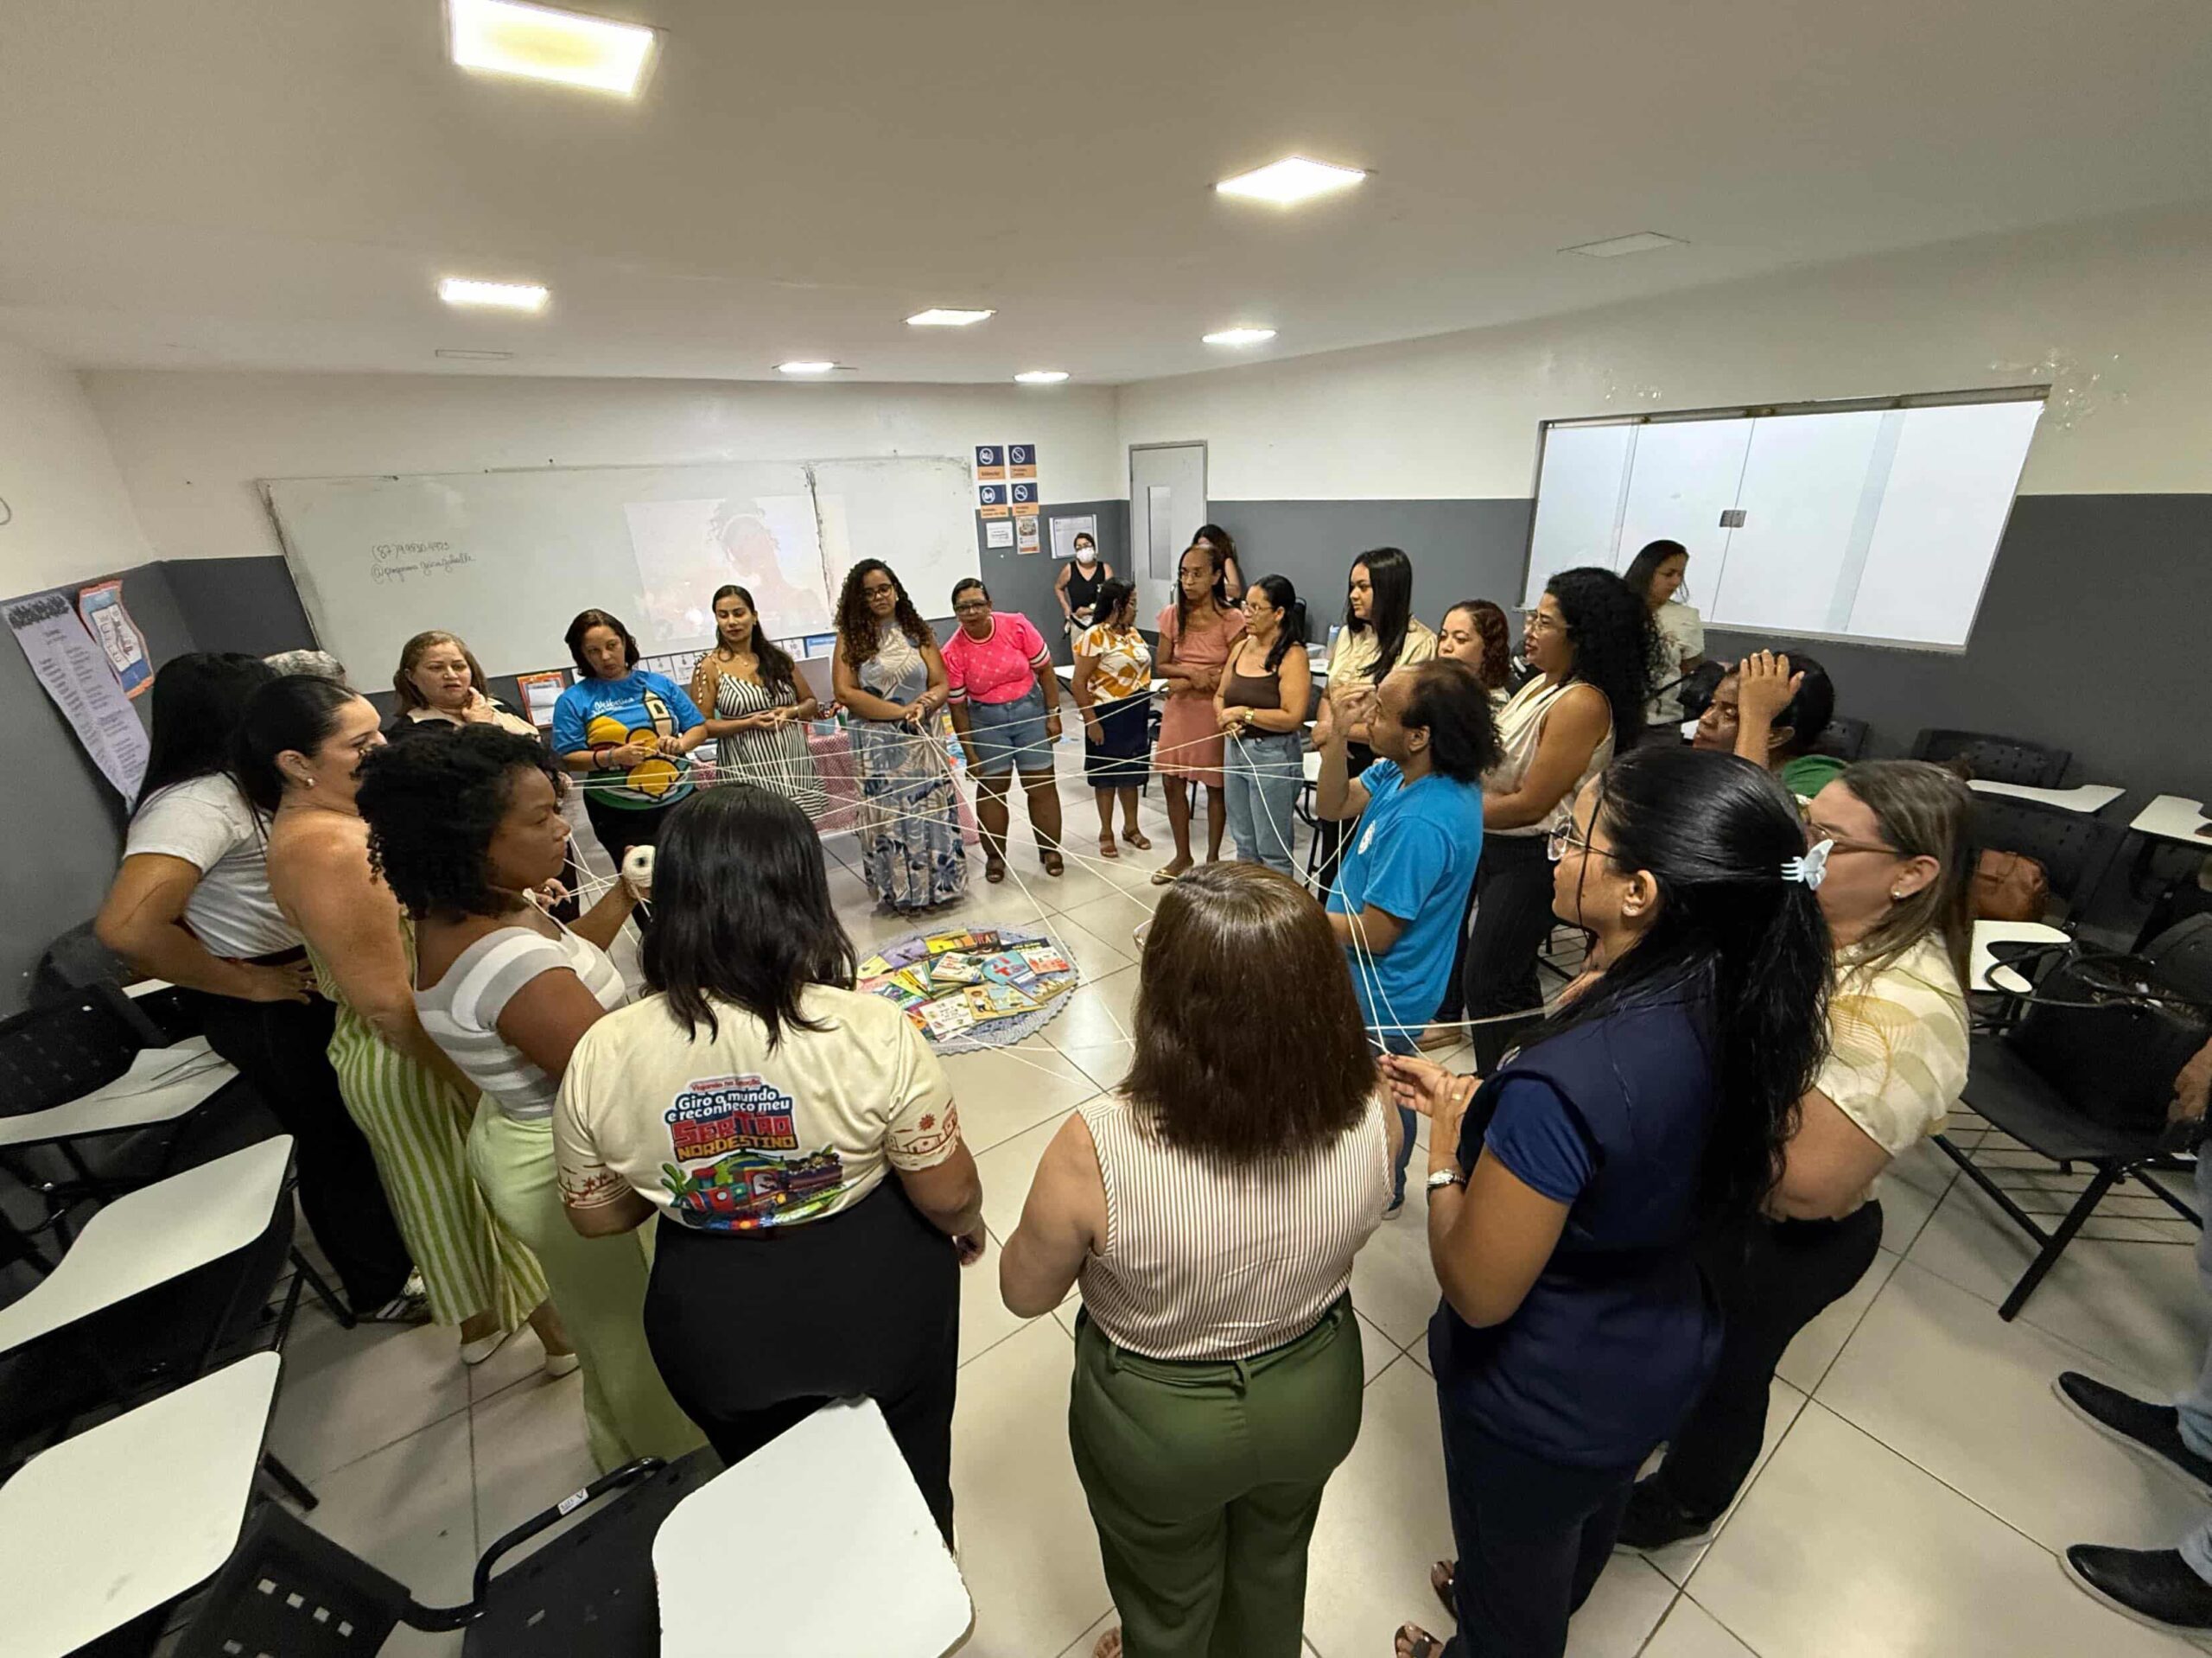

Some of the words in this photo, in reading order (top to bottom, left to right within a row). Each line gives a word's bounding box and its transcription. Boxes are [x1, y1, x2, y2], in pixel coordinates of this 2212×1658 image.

[678, 1094, 713, 1110] Giro
[728, 1087, 778, 1103] mundo
[667, 1113, 677, 1122] e
[679, 1100, 755, 1121] reconheço
[757, 1099, 791, 1113] meu
[677, 1134, 797, 1160] NORDESTINO
